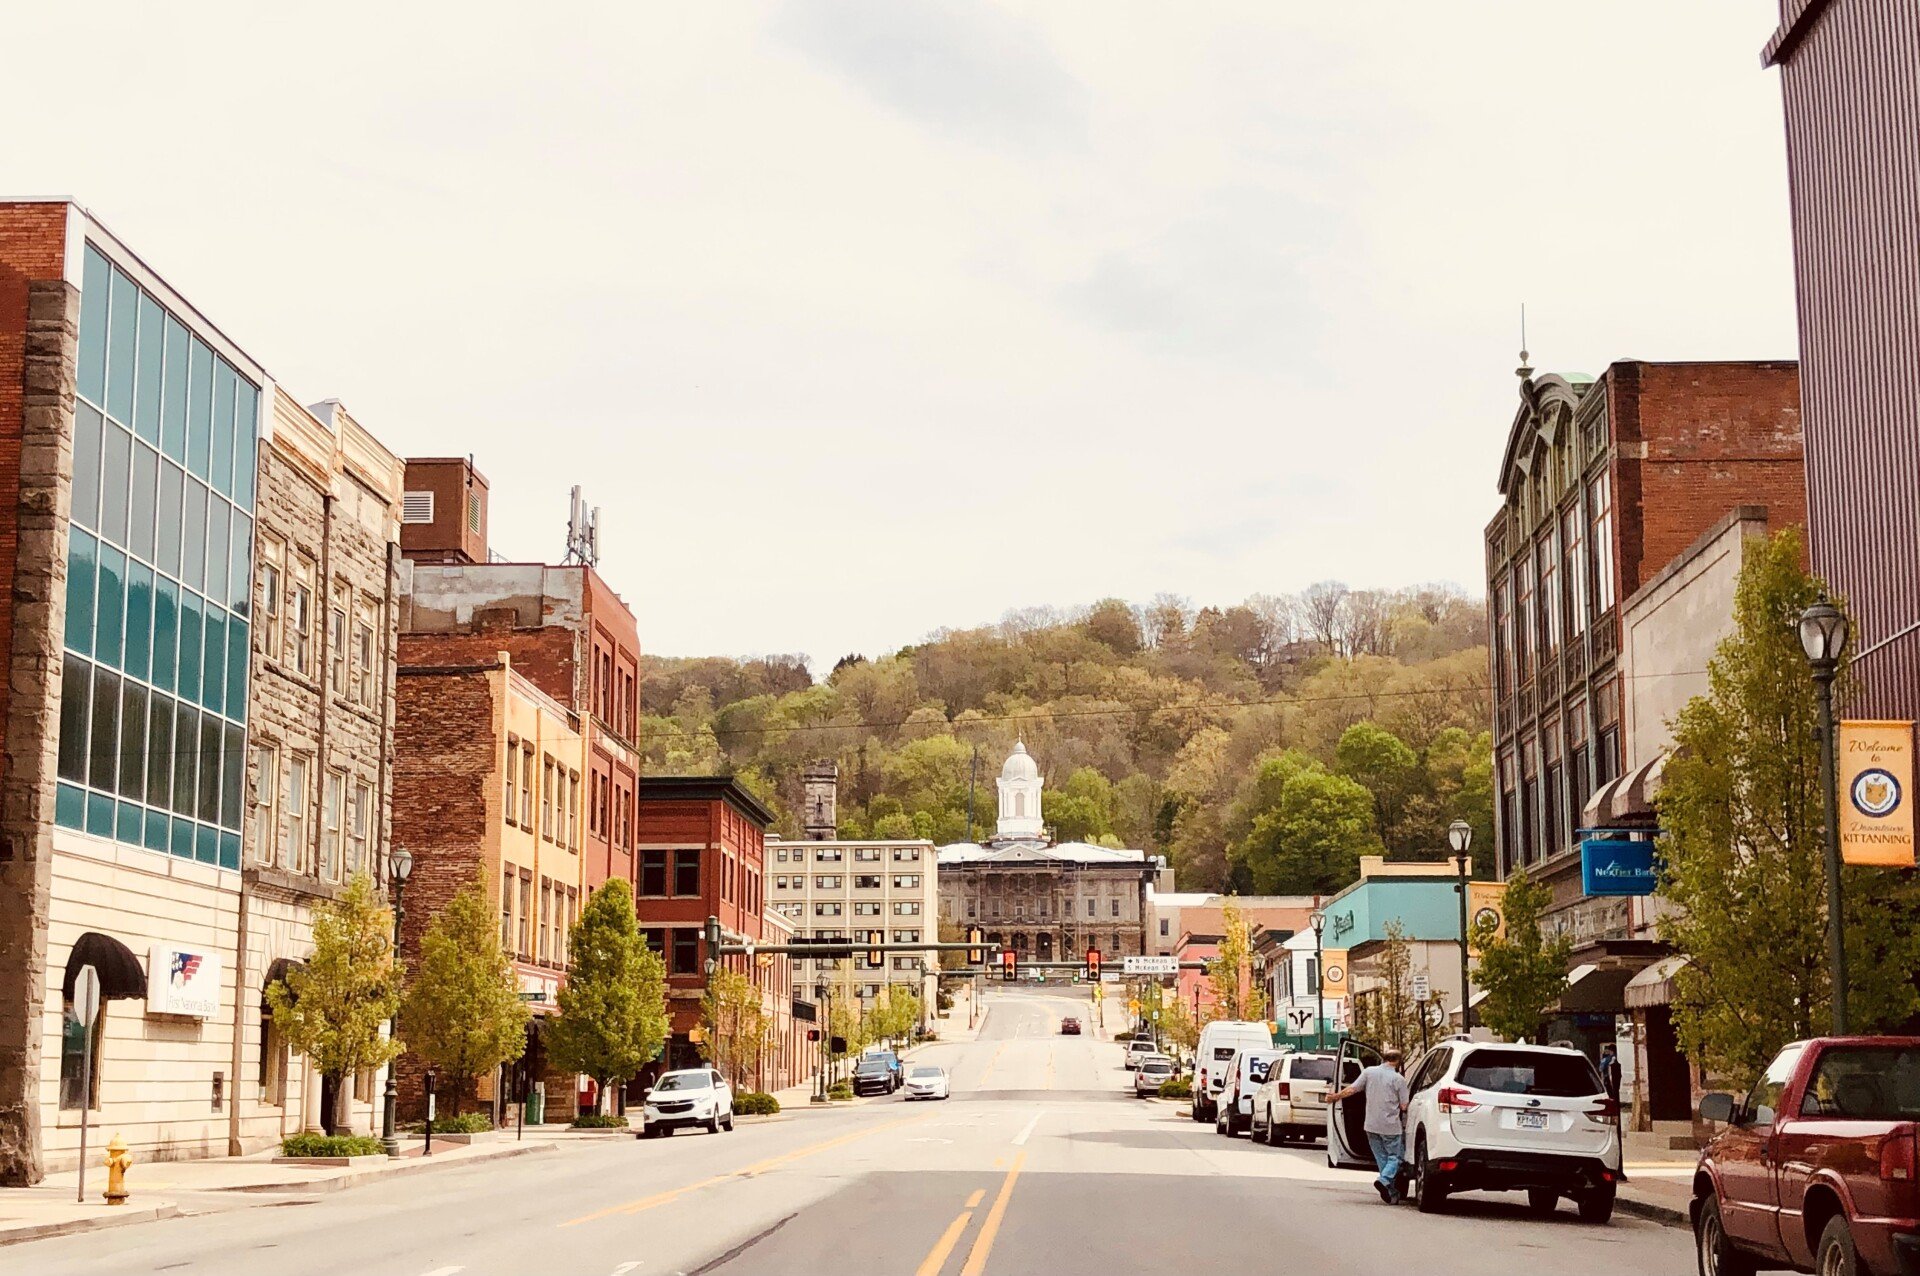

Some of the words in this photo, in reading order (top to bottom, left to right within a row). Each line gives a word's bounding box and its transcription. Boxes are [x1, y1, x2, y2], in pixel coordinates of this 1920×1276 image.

[1849, 740, 1903, 752] Welcome
[1870, 753, 1881, 763] to
[1850, 822, 1904, 832] Downtown
[1843, 833, 1911, 844] KITTANNING
[169, 995, 180, 1007] First
[181, 997, 203, 1012] National
[203, 999, 217, 1013] Bank
